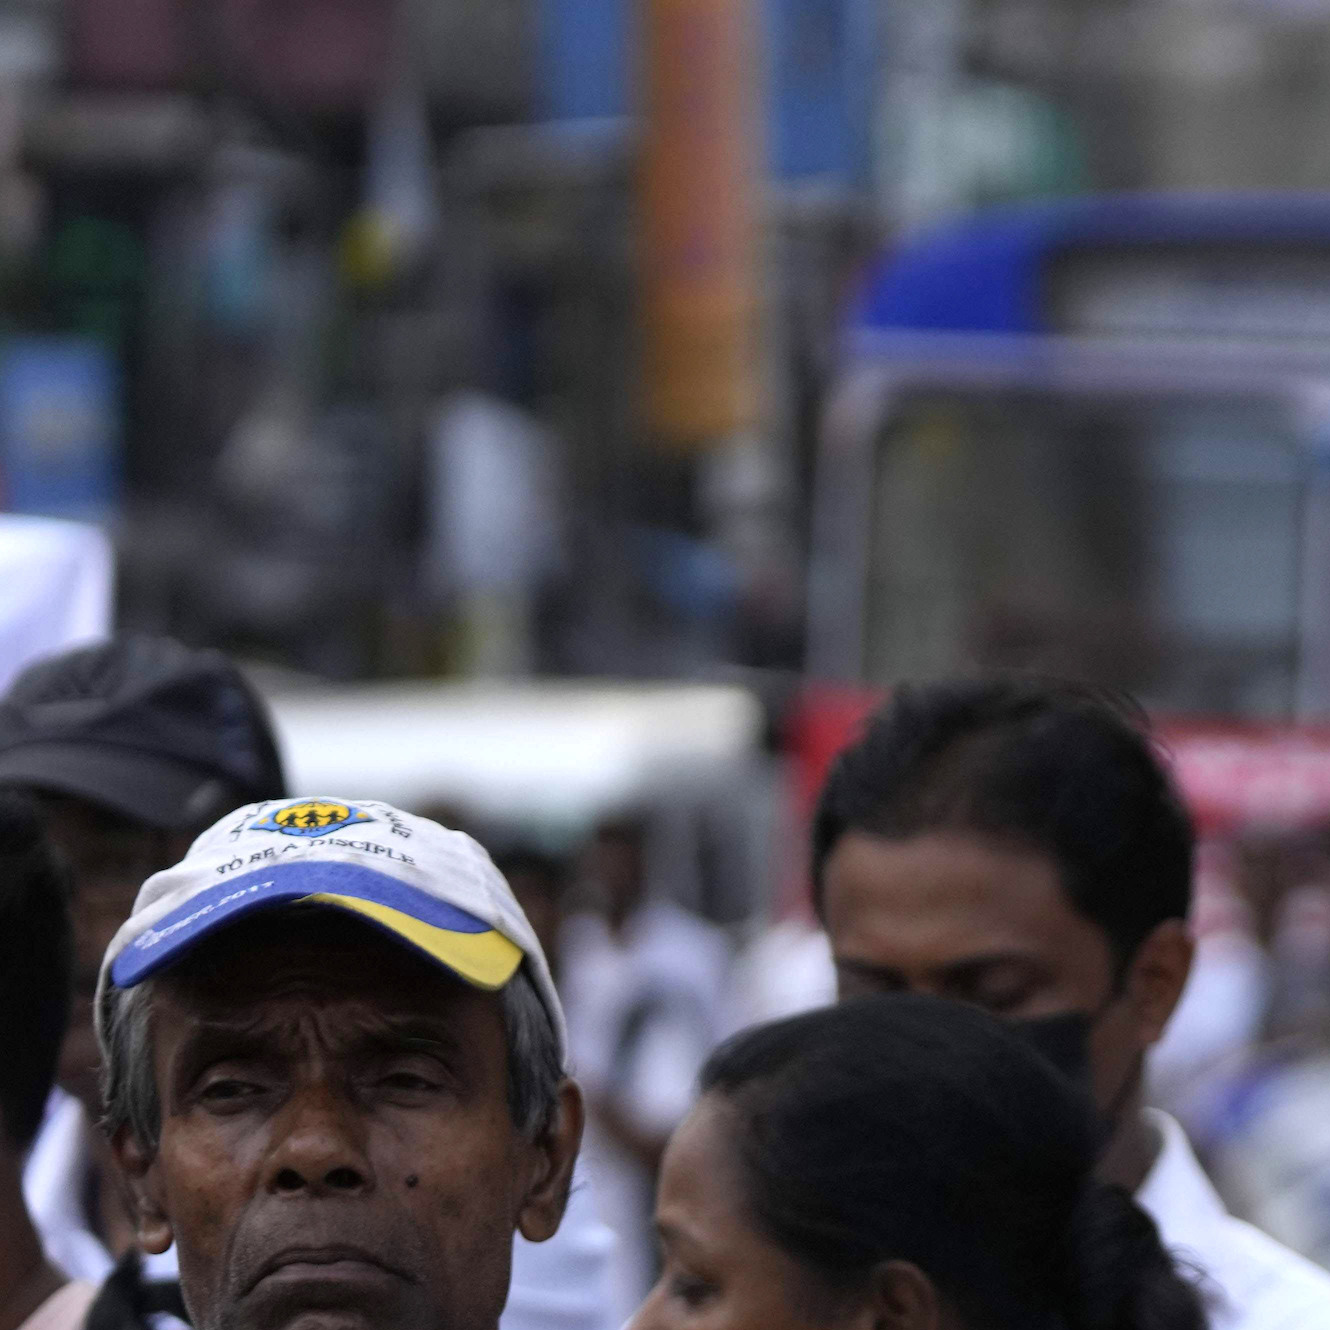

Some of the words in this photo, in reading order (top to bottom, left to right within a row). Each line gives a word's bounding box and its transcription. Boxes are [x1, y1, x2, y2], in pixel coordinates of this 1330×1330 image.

[216, 858, 244, 875] TO
[249, 848, 274, 865] BE
[281, 843, 299, 854] A
[309, 838, 416, 866] DISCIPLE
